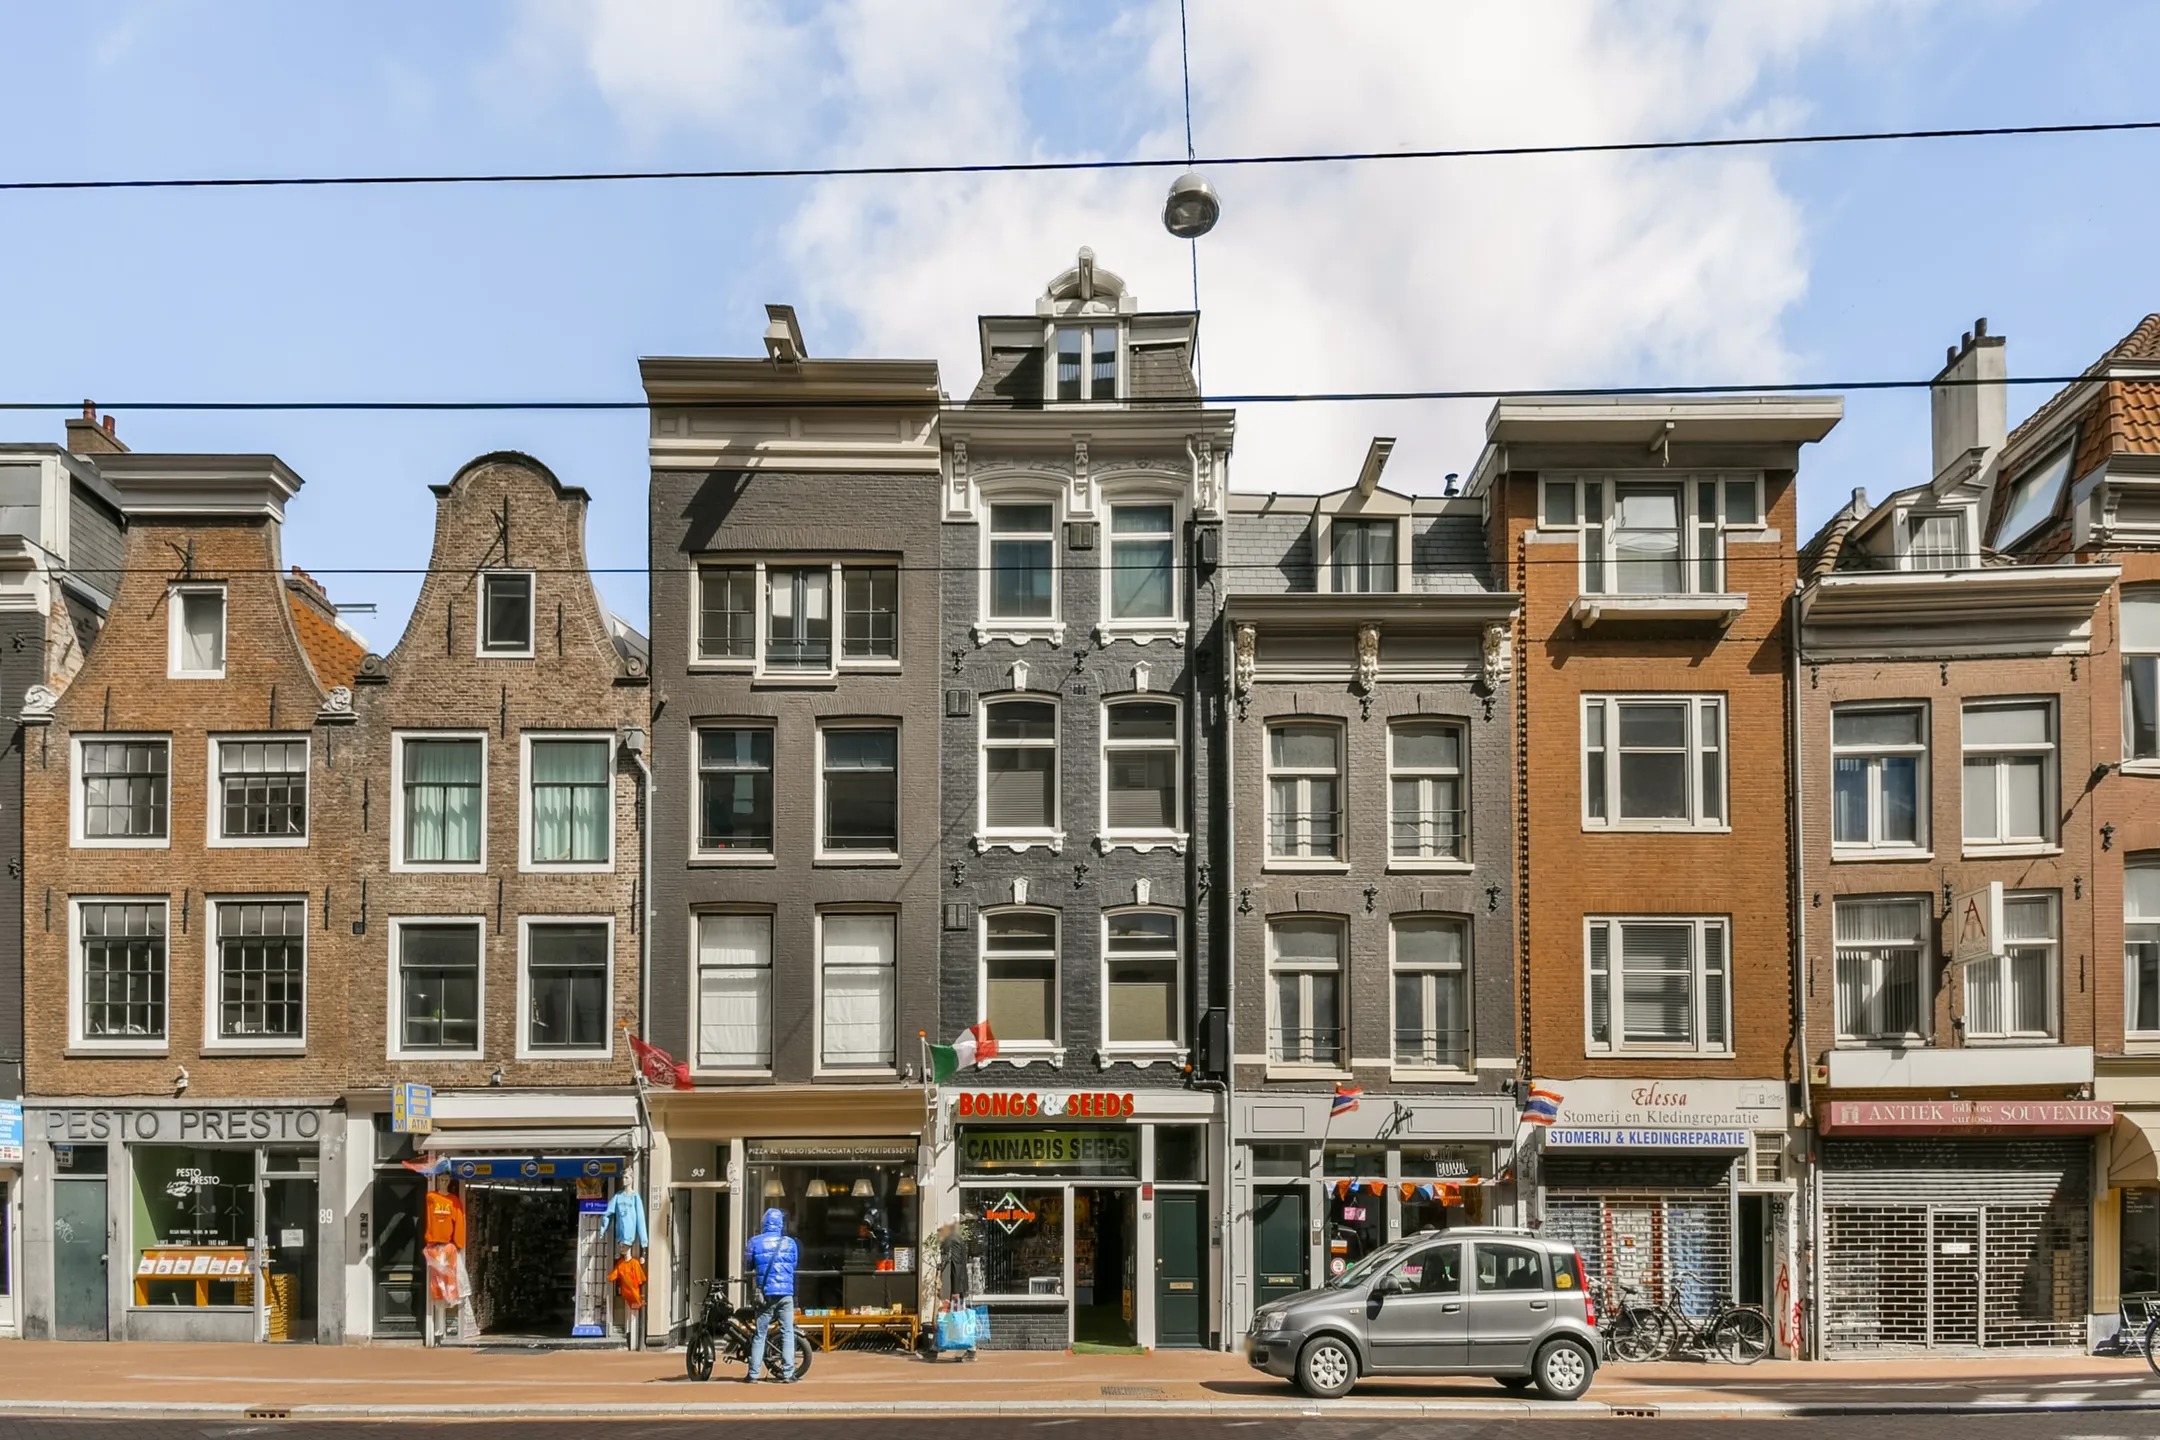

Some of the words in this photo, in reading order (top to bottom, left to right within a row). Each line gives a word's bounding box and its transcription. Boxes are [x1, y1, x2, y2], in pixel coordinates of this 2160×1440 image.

[1631, 1082, 1687, 1106] Edessa
[959, 1092, 1038, 1117] BONGS
[1044, 1092, 1063, 1116] &
[1067, 1093, 1134, 1117] SEEDS
[1563, 1110, 1620, 1125] Stomerij
[1625, 1113, 1640, 1122] en
[1647, 1110, 1759, 1125] Kledingreparatie
[1868, 1105, 1945, 1120] ANTIEK
[2001, 1105, 2112, 1121] SOUVENIRS
[46, 1110, 159, 1139] PESTO
[180, 1108, 320, 1139] PRESTO
[412, 1119, 428, 1130] ATM
[1550, 1131, 1611, 1144] STOMERIJ
[1616, 1131, 1624, 1144] &
[1629, 1131, 1744, 1145] KLEDINGREPARATIE
[966, 1138, 1063, 1160] CANNABIS
[1070, 1138, 1129, 1160] SEEDS
[176, 1168, 201, 1177] PESTO
[691, 1168, 705, 1177] 93
[1436, 1159, 1468, 1178] BOWL
[190, 1176, 220, 1185] PRESTO
[320, 1209, 333, 1223] 89
